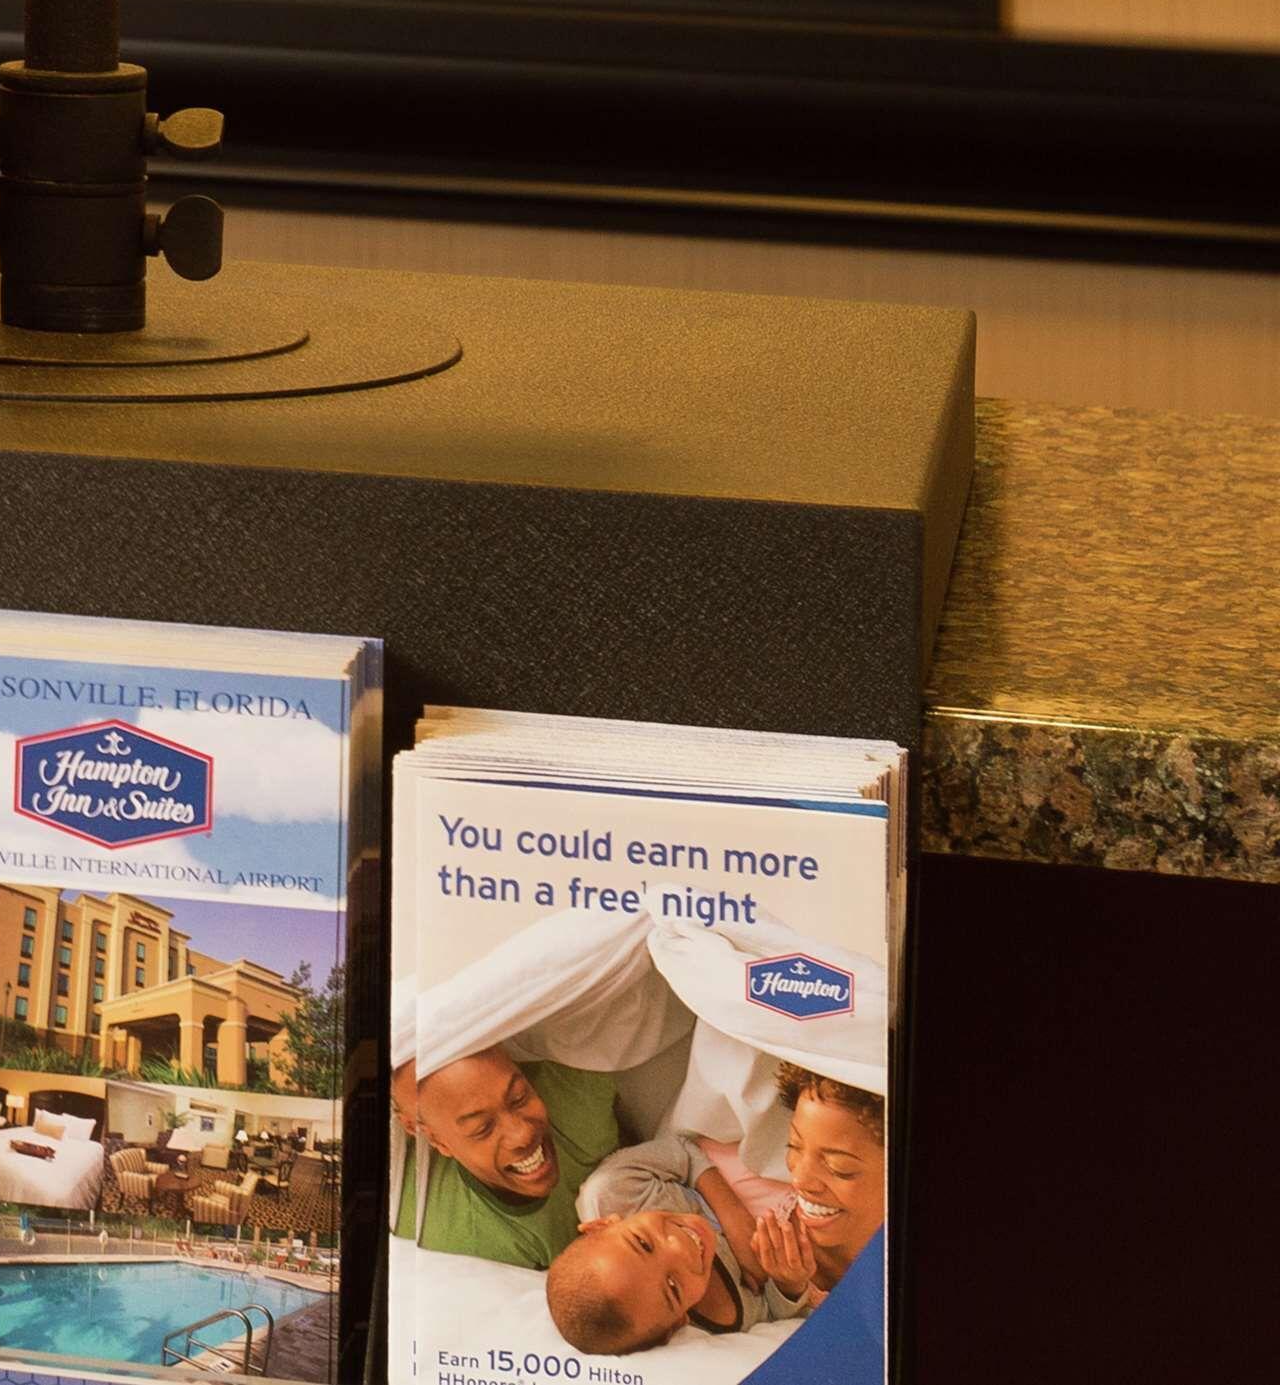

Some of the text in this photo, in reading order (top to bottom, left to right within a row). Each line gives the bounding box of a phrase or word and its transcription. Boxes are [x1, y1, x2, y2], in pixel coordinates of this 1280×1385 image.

[175, 689, 314, 721] FLORIDA
[38, 749, 183, 793] Hampton
[31, 790, 196, 825] Inn & Suites
[438, 814, 820, 882] You could earn more
[61, 856, 229, 887] INTERNATIONAL
[234, 872, 324, 894] AIRPORT
[438, 864, 521, 904] than
[533, 883, 555, 907] a
[661, 886, 758, 927] night
[750, 972, 849, 1002] Hampton
[438, 1349, 644, 1385] Earn 15,000 Hilton
